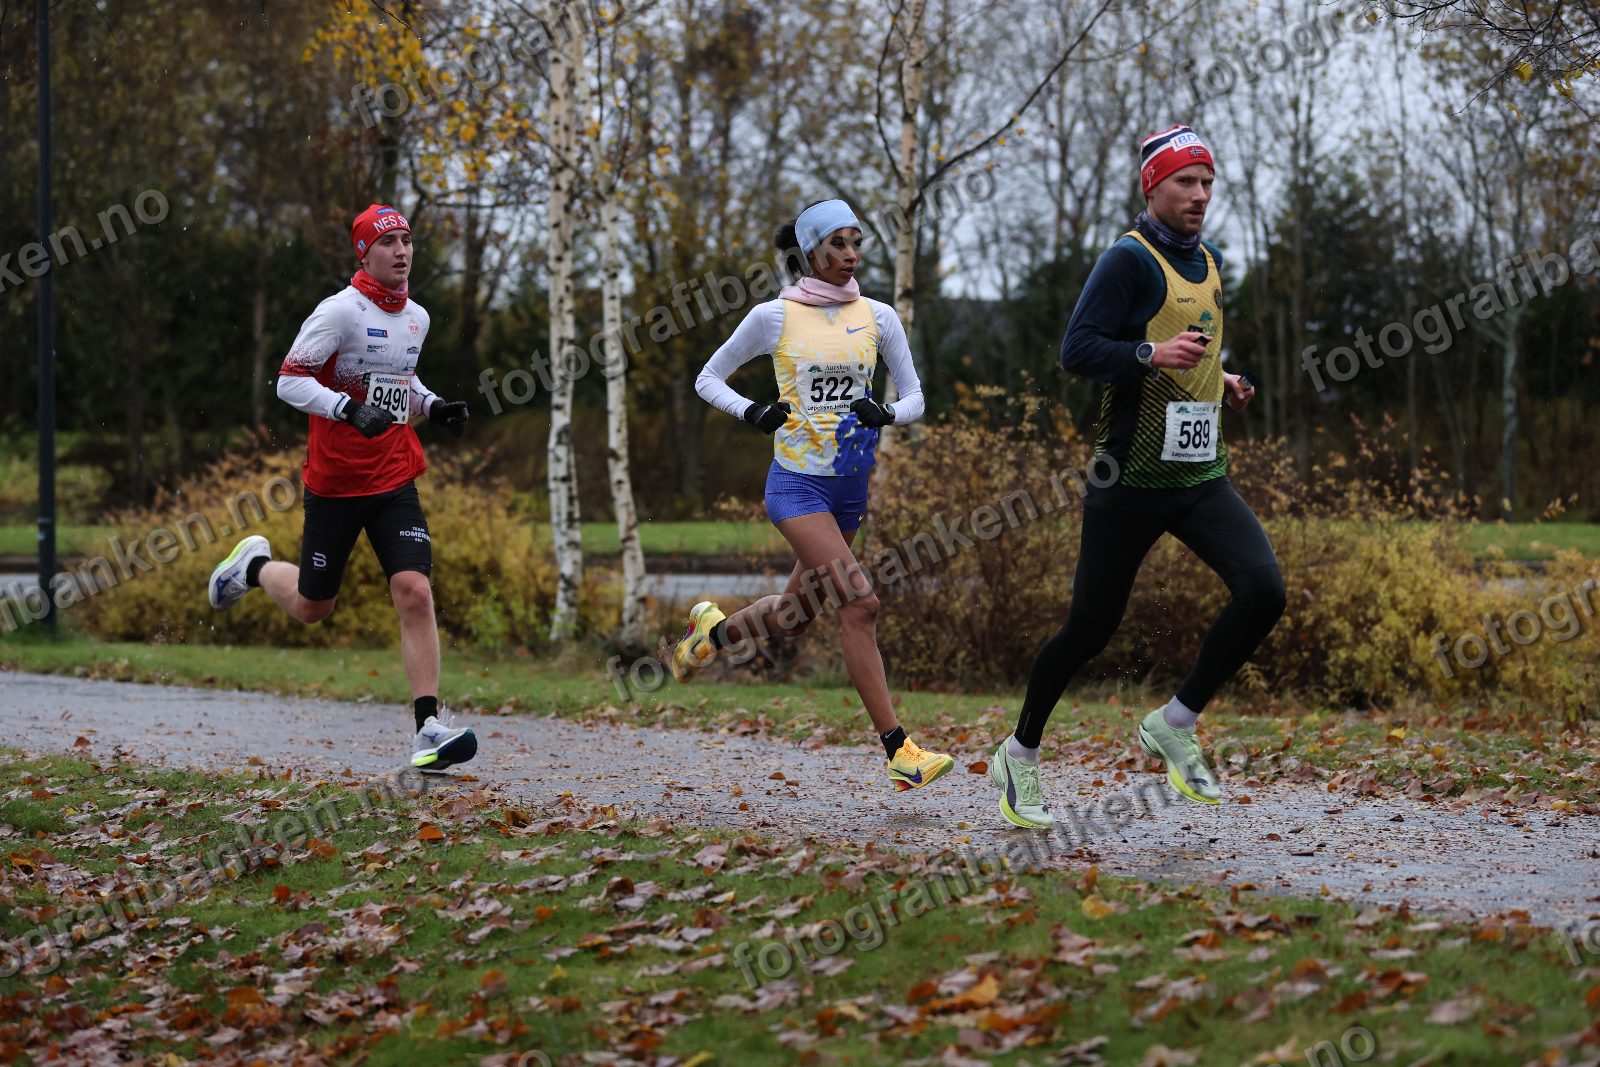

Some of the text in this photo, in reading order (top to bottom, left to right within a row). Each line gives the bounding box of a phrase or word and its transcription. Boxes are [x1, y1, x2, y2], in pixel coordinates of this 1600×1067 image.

[373, 215, 397, 232] NES
[824, 364, 851, 372] Aurskog
[371, 386, 408, 412] 9490
[810, 376, 854, 403] 522
[1178, 419, 1210, 450] 589
